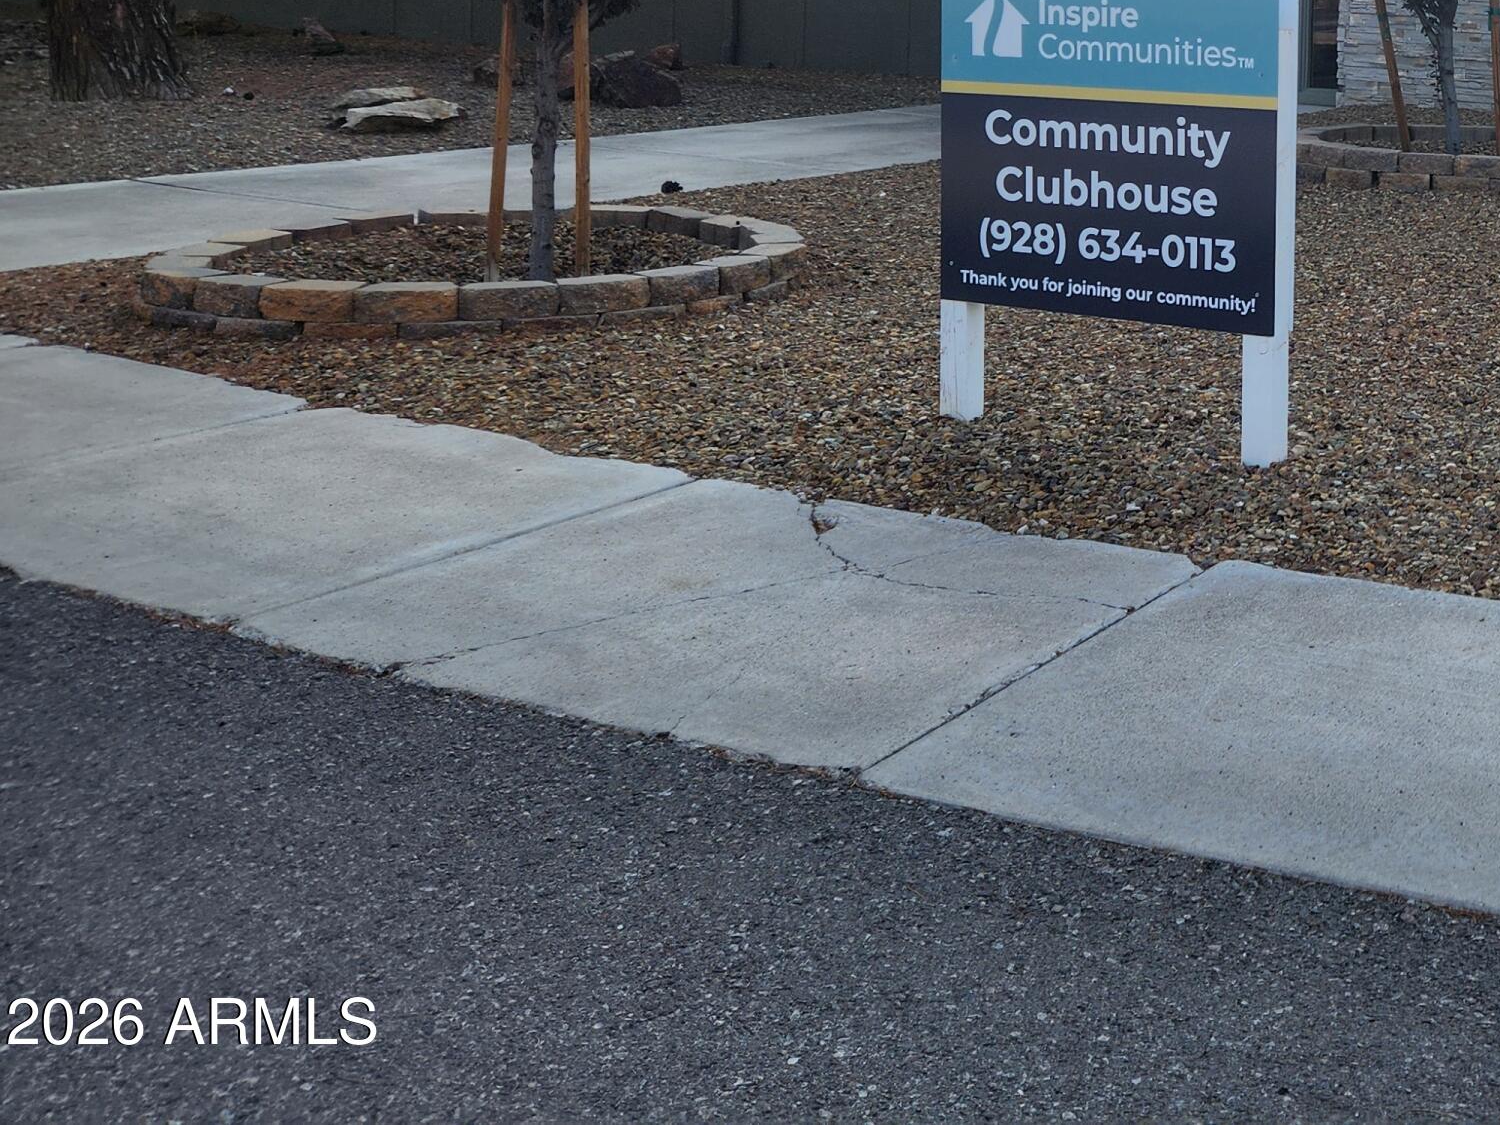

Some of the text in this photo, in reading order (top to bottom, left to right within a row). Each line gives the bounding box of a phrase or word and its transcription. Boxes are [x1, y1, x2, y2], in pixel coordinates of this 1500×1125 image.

[984, 108, 1231, 169] Community
[995, 165, 1218, 217] Clubhouse
[979, 216, 1237, 273] (928) 634-0113
[960, 269, 1257, 314] Thank you for joining our community!
